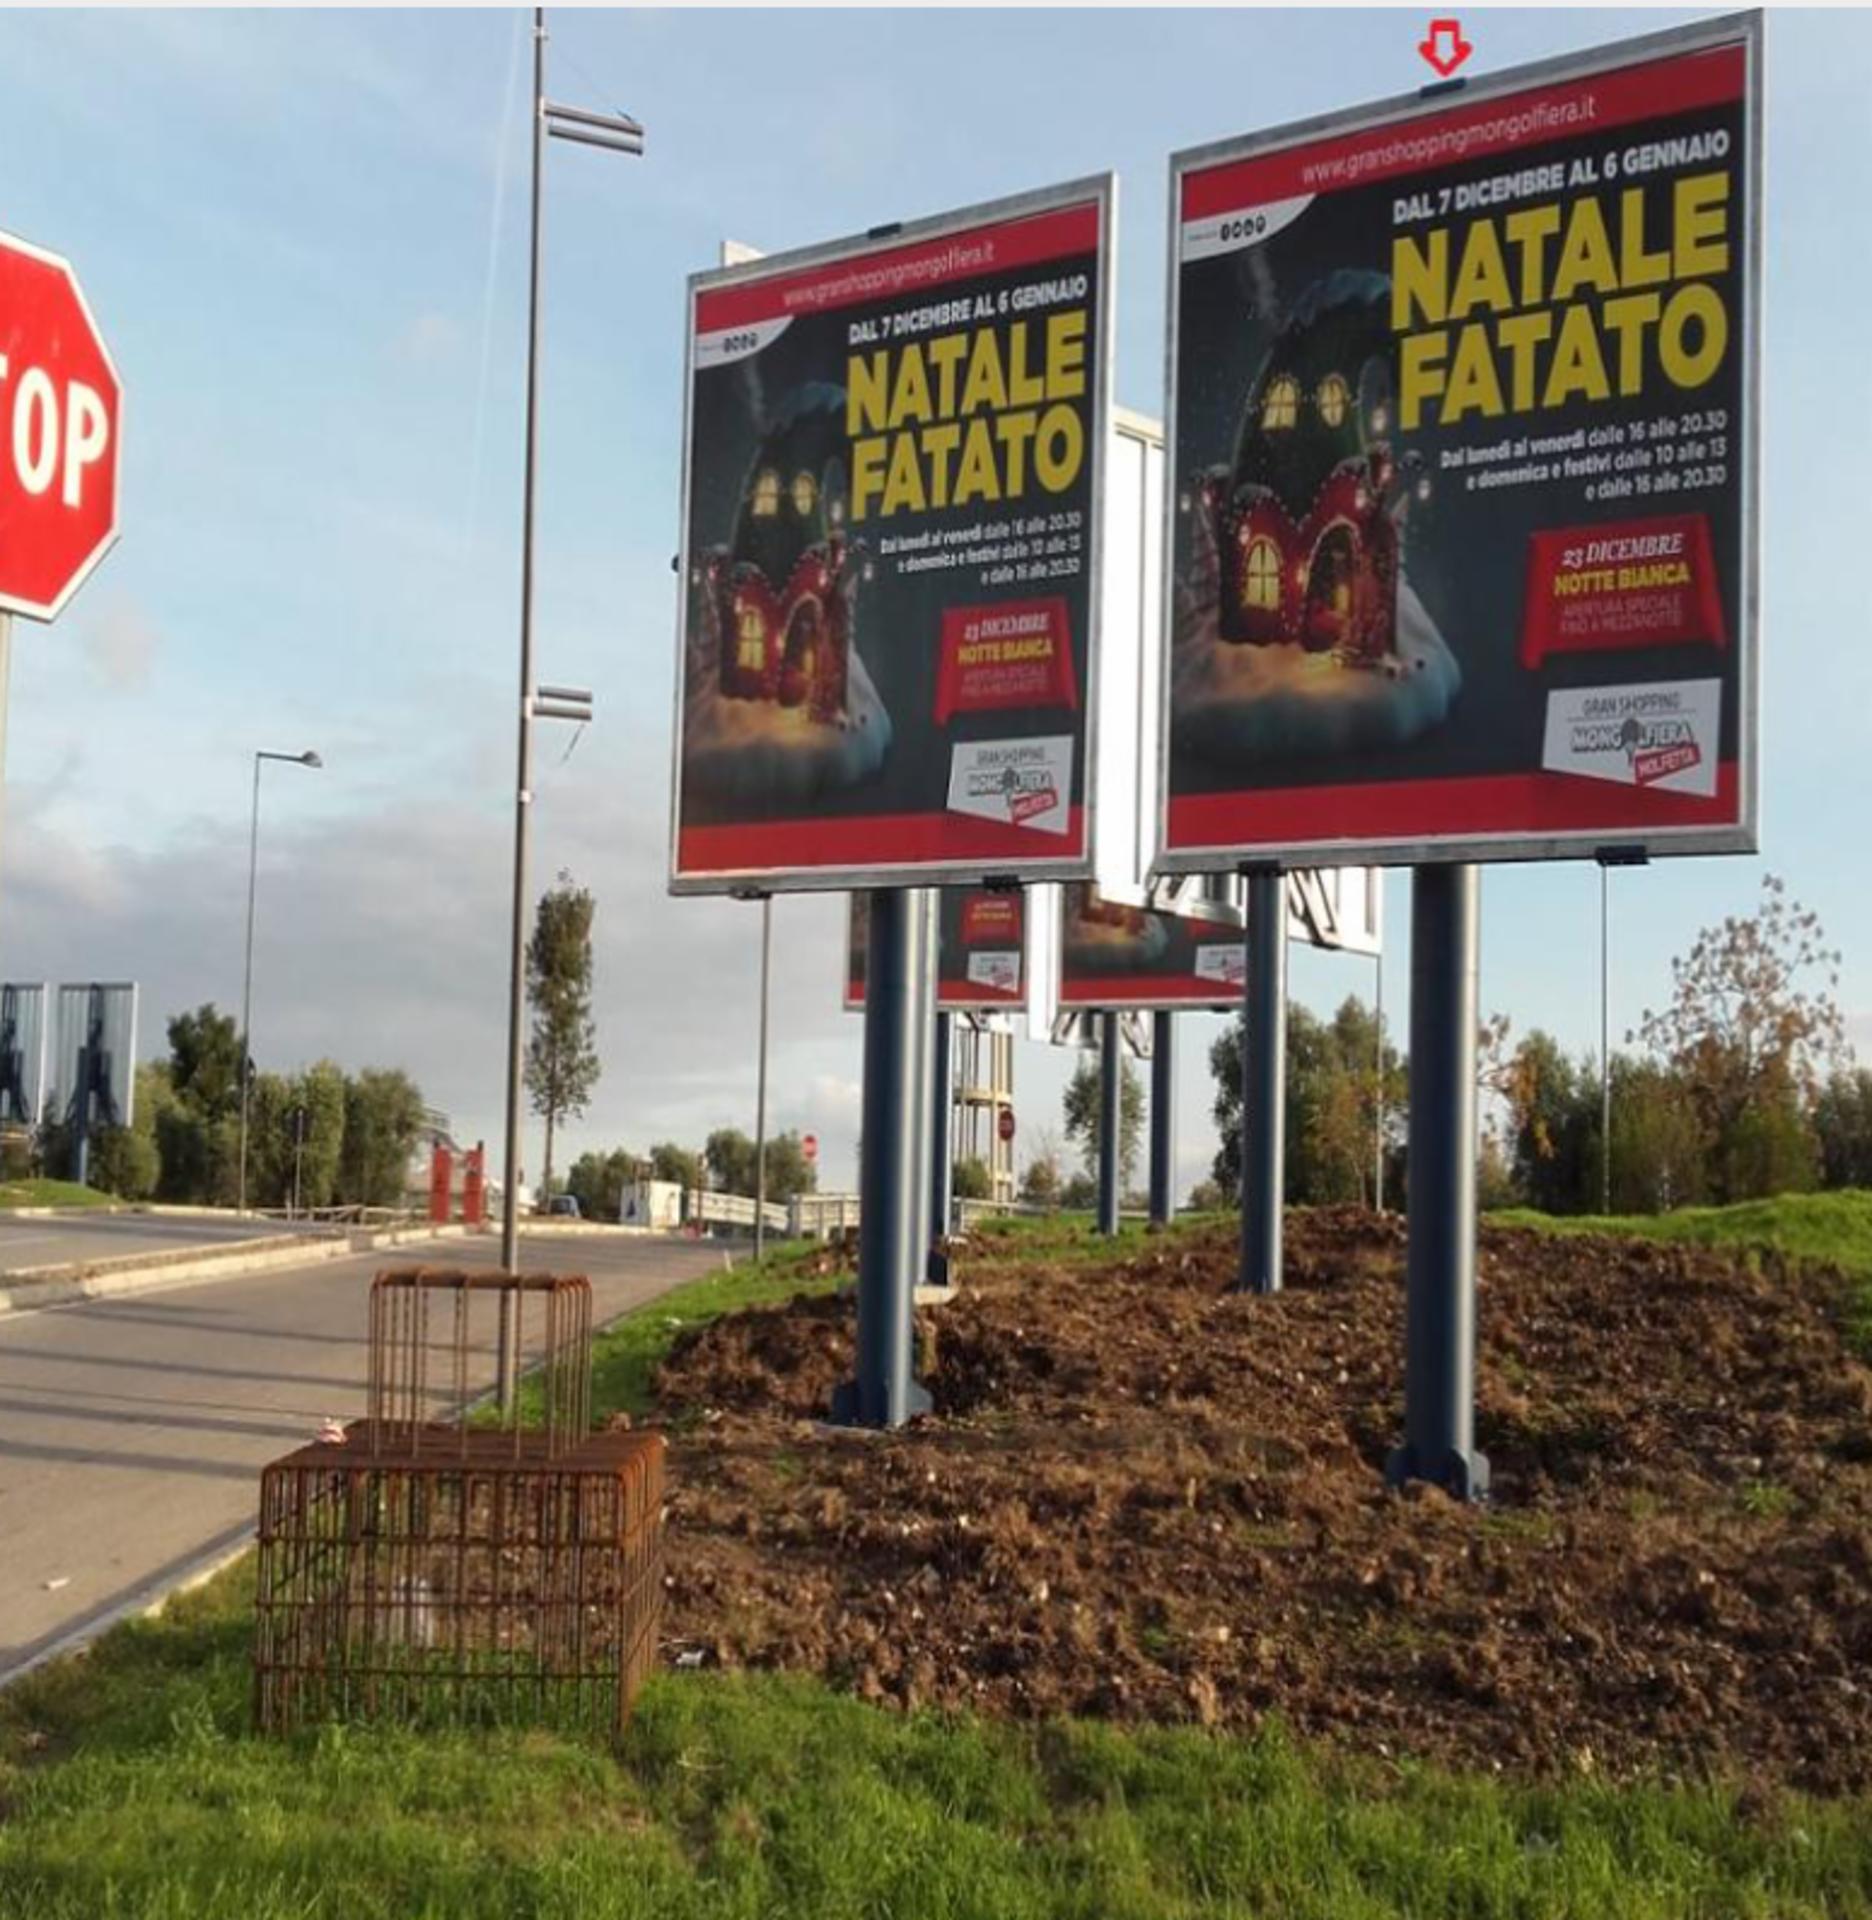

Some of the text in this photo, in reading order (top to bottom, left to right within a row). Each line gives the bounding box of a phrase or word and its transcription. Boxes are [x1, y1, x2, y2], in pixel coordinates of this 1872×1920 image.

[1303, 96, 1595, 183] www.granshoppingmongolfiera.it
[1393, 130, 1730, 224] DAL 7 DICEMBRE AL 6 GENNAIO
[1391, 171, 1729, 331] NATALE
[849, 275, 1088, 344] DAL 7 DICEMBRE AL 6 GENNAIO
[846, 310, 1087, 435] NATALE
[1398, 284, 1729, 430] FATATO
[0, 354, 108, 509] OP
[852, 403, 1084, 521] FATATO
[1466, 436, 1727, 490] e domenica e festivi dalle 10 alle 13
[1588, 423, 1624, 446] dalle
[1629, 421, 1645, 441] 16
[1650, 416, 1676, 439] alle
[1680, 410, 1727, 434] 20.30
[1585, 485, 1595, 500] e
[1598, 477, 1632, 499] dalle
[1654, 471, 1679, 492] alle
[1683, 465, 1727, 488] 20.30
[1554, 561, 1691, 596] NOTTE BIANCA
[1561, 532, 1685, 568] 23 DICEMBRE
[958, 642, 1000, 665] NOTTE
